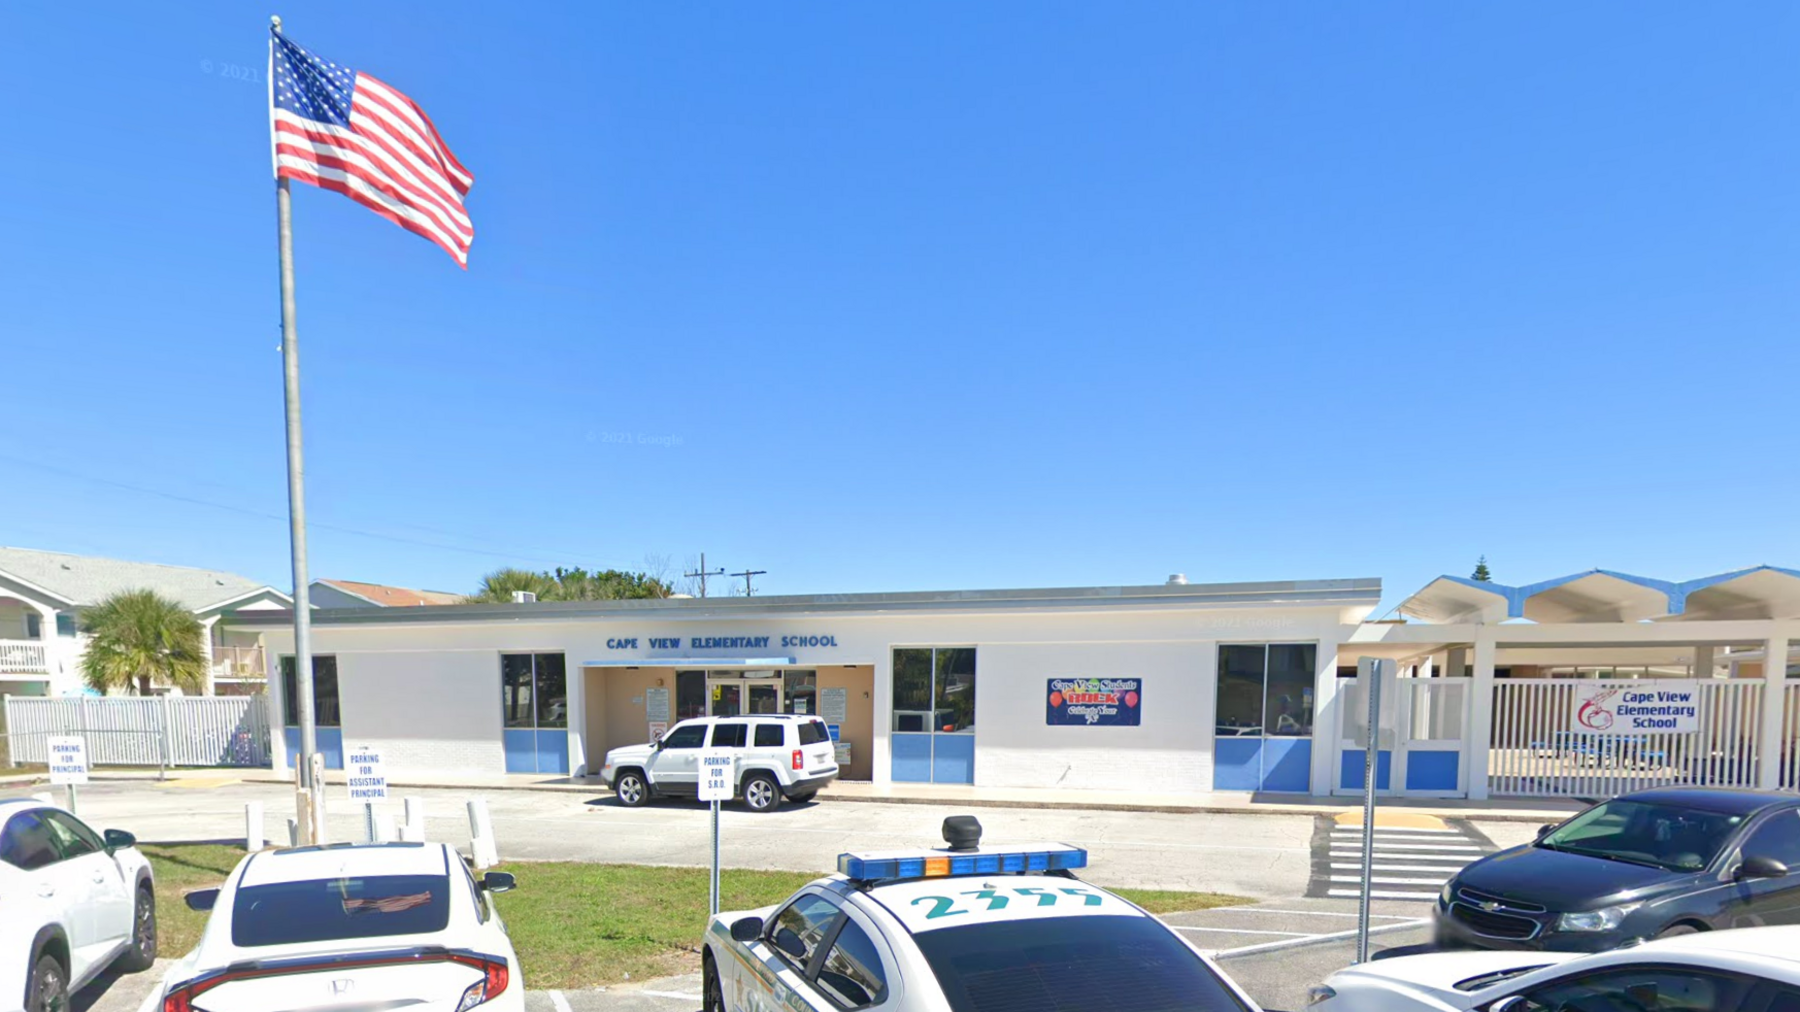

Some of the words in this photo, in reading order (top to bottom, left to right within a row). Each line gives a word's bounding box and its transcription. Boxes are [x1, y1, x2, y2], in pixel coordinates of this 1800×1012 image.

[606, 638, 638, 650] CAPE
[649, 638, 681, 649] VIEW
[691, 636, 770, 649] ELEMENTARY
[781, 635, 838, 648] SCHOOL
[1051, 680, 1074, 691] Cape
[1073, 678, 1099, 690] View
[1100, 679, 1137, 690] Students
[1067, 692, 1119, 705] ROCK
[1622, 691, 1655, 704] Cape
[1657, 691, 1691, 702] View
[1616, 705, 1695, 717] Elementary
[1633, 717, 1677, 728] School
[350, 754, 379, 764] PARKING
[704, 756, 731, 766] PARKING
[52, 765, 85, 773] PRINCIPAL
[360, 766, 373, 775] FOR
[711, 768, 723, 777] FOR
[349, 777, 385, 787] ASSISTANT
[351, 789, 385, 798] PRINCIPAL
[910, 887, 1103, 920] 2355
